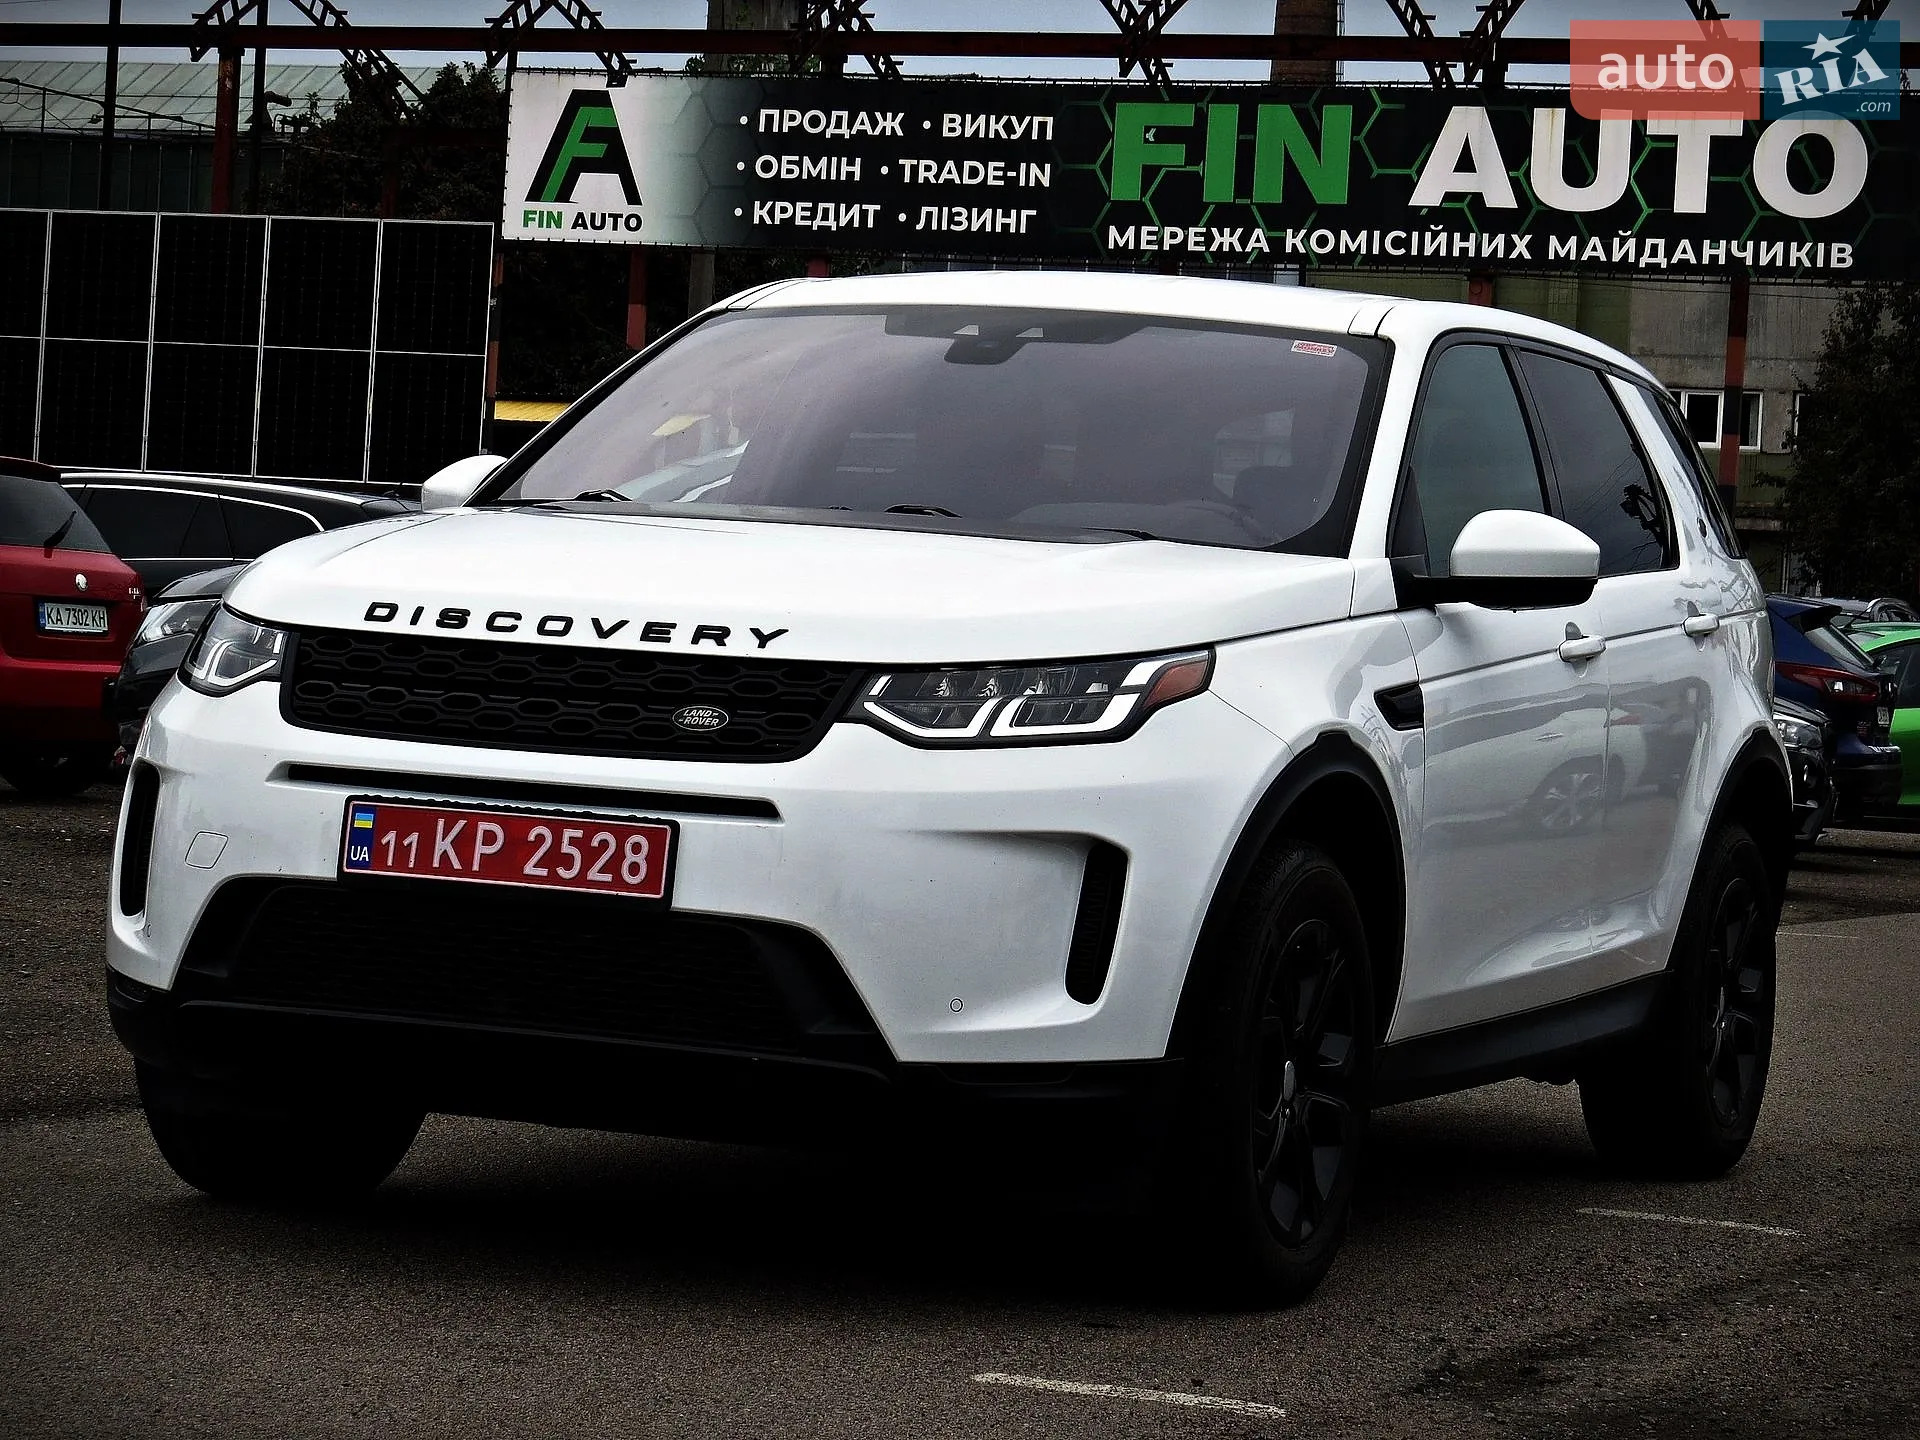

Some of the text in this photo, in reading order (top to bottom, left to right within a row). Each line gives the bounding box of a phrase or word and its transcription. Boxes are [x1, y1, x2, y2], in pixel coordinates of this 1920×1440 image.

[758, 109, 1053, 141] ПРОДАЖ ВИКУП
[755, 154, 861, 182] ОБМІН
[899, 159, 1051, 187] TRADE-IN
[1110, 102, 1868, 219] FIN AUTO
[522, 210, 642, 232] FIN AUTO
[752, 202, 1036, 234] КРЕДИТ ЛІЗИНГ
[1107, 223, 1854, 269] МЕРЕЖА КОМІСІЙНИХ МАЙДАНЧИКІВ
[46, 606, 106, 628] KA 7302 KH
[364, 602, 788, 648] DISCOVERY
[351, 845, 369, 862] UA
[523, 825, 649, 885] 2528
